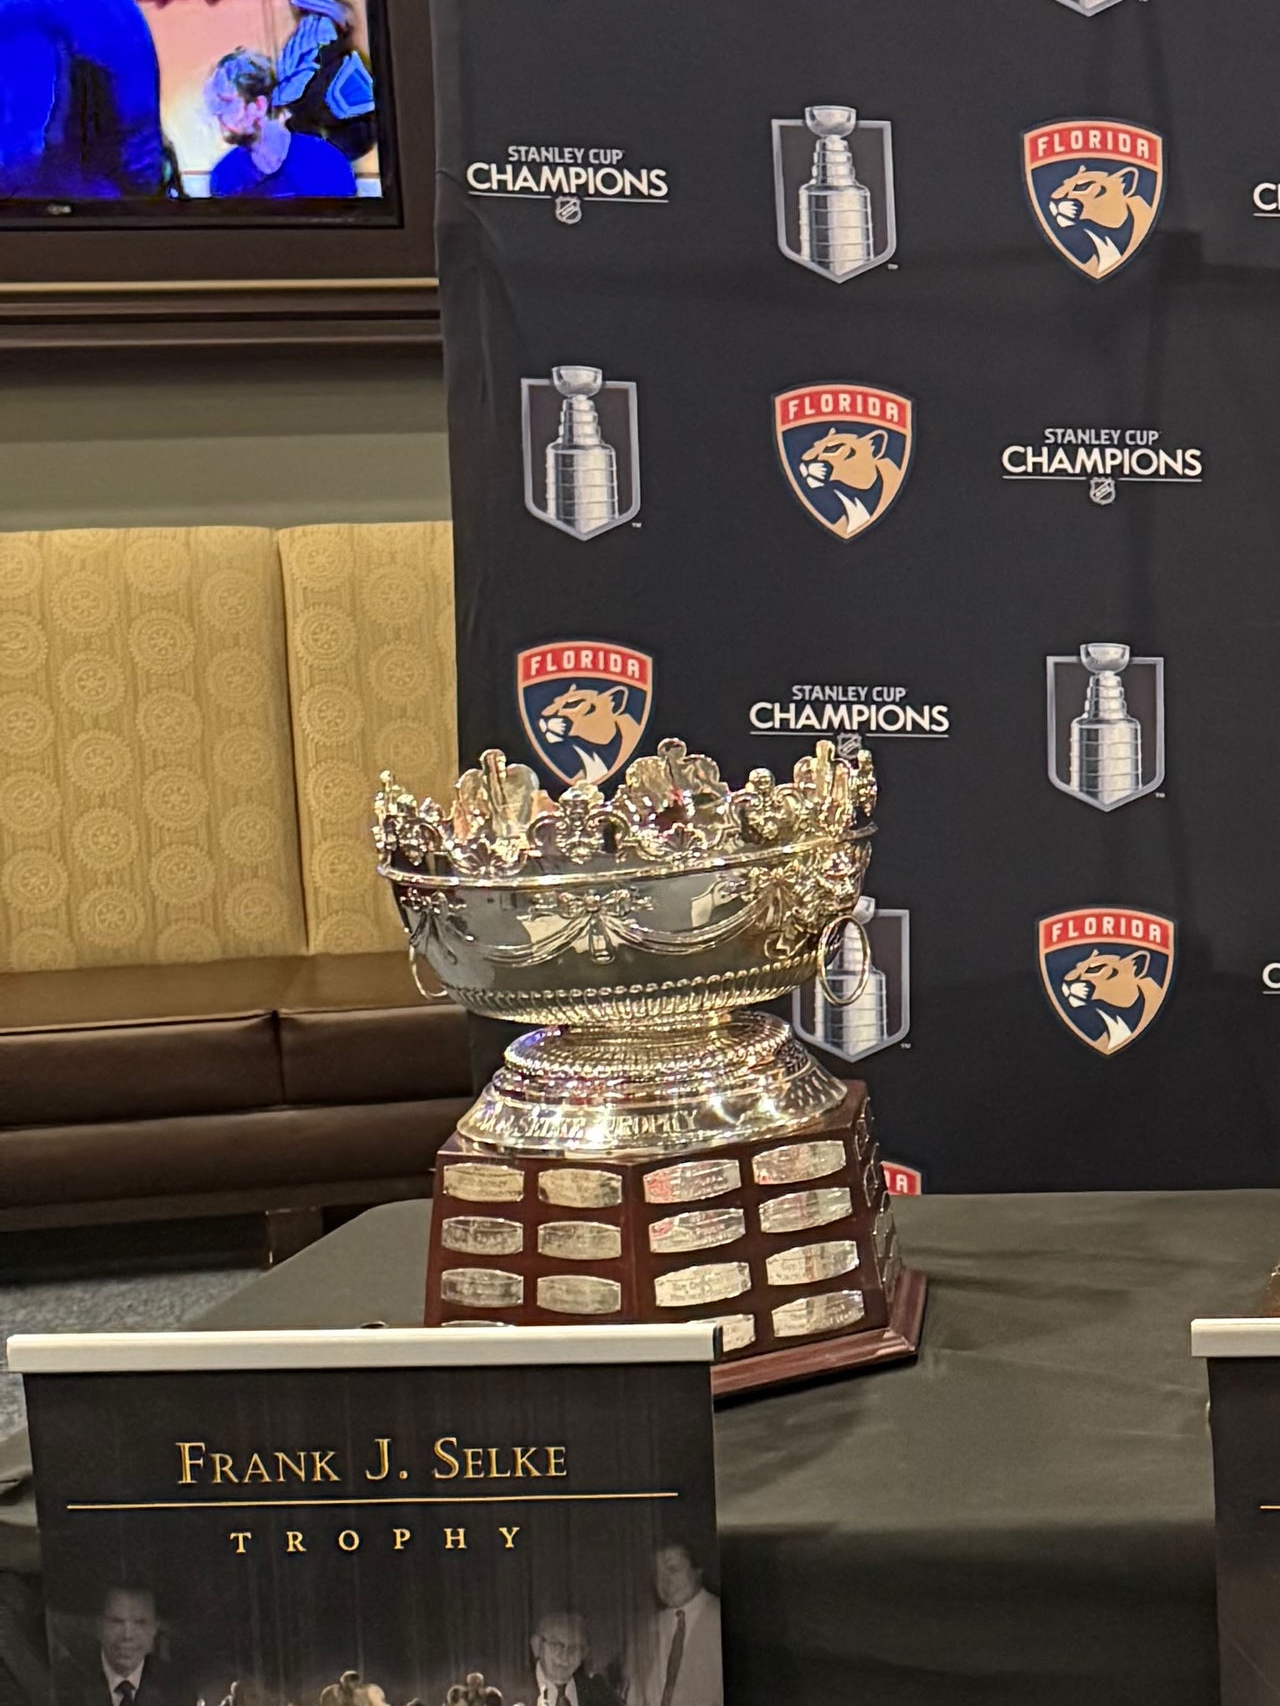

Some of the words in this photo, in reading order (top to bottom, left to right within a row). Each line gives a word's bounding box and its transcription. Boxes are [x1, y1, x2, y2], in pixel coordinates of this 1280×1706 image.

[508, 146, 584, 163] STANLEY
[589, 149, 622, 164] CUP
[1038, 130, 1148, 158] FLORIDA
[467, 163, 668, 196] CHAMPIONS
[789, 394, 898, 421] FLORIDA
[1045, 429, 1120, 444] STANLEY
[1126, 430, 1158, 445] CUP
[1002, 446, 1202, 476] CHAMPIONS
[532, 651, 638, 678] FLORIDA
[792, 685, 868, 701] STANLEY
[873, 687, 906, 701] CUP
[750, 702, 949, 731] CHAMPIONS
[1053, 917, 1160, 942] FLORIDA
[365, 1438, 409, 1480] J.
[229, 1526, 520, 1554] TROPHY
